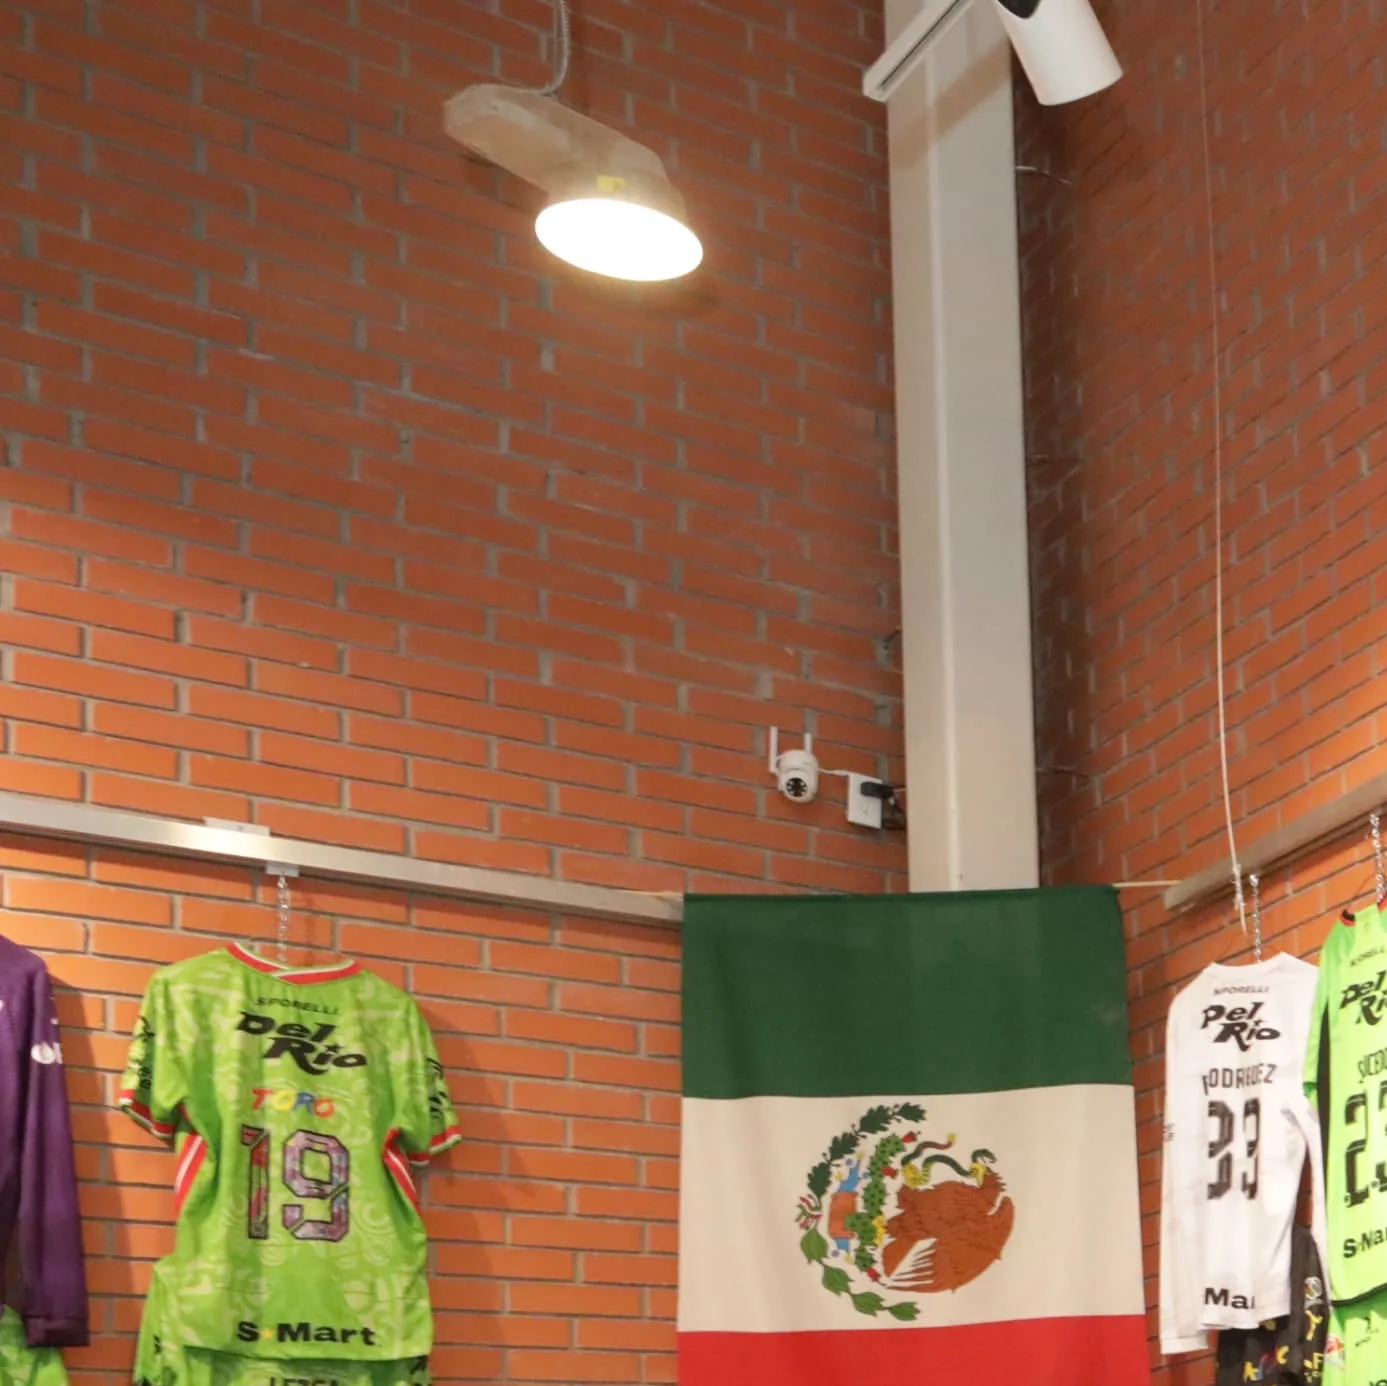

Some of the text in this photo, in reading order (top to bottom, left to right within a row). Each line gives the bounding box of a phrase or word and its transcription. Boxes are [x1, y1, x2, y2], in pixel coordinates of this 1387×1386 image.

[238, 1011, 338, 1043] Del
[263, 1037, 367, 1075] Rio
[252, 1088, 334, 1118] TORO
[241, 1125, 351, 1242] 19
